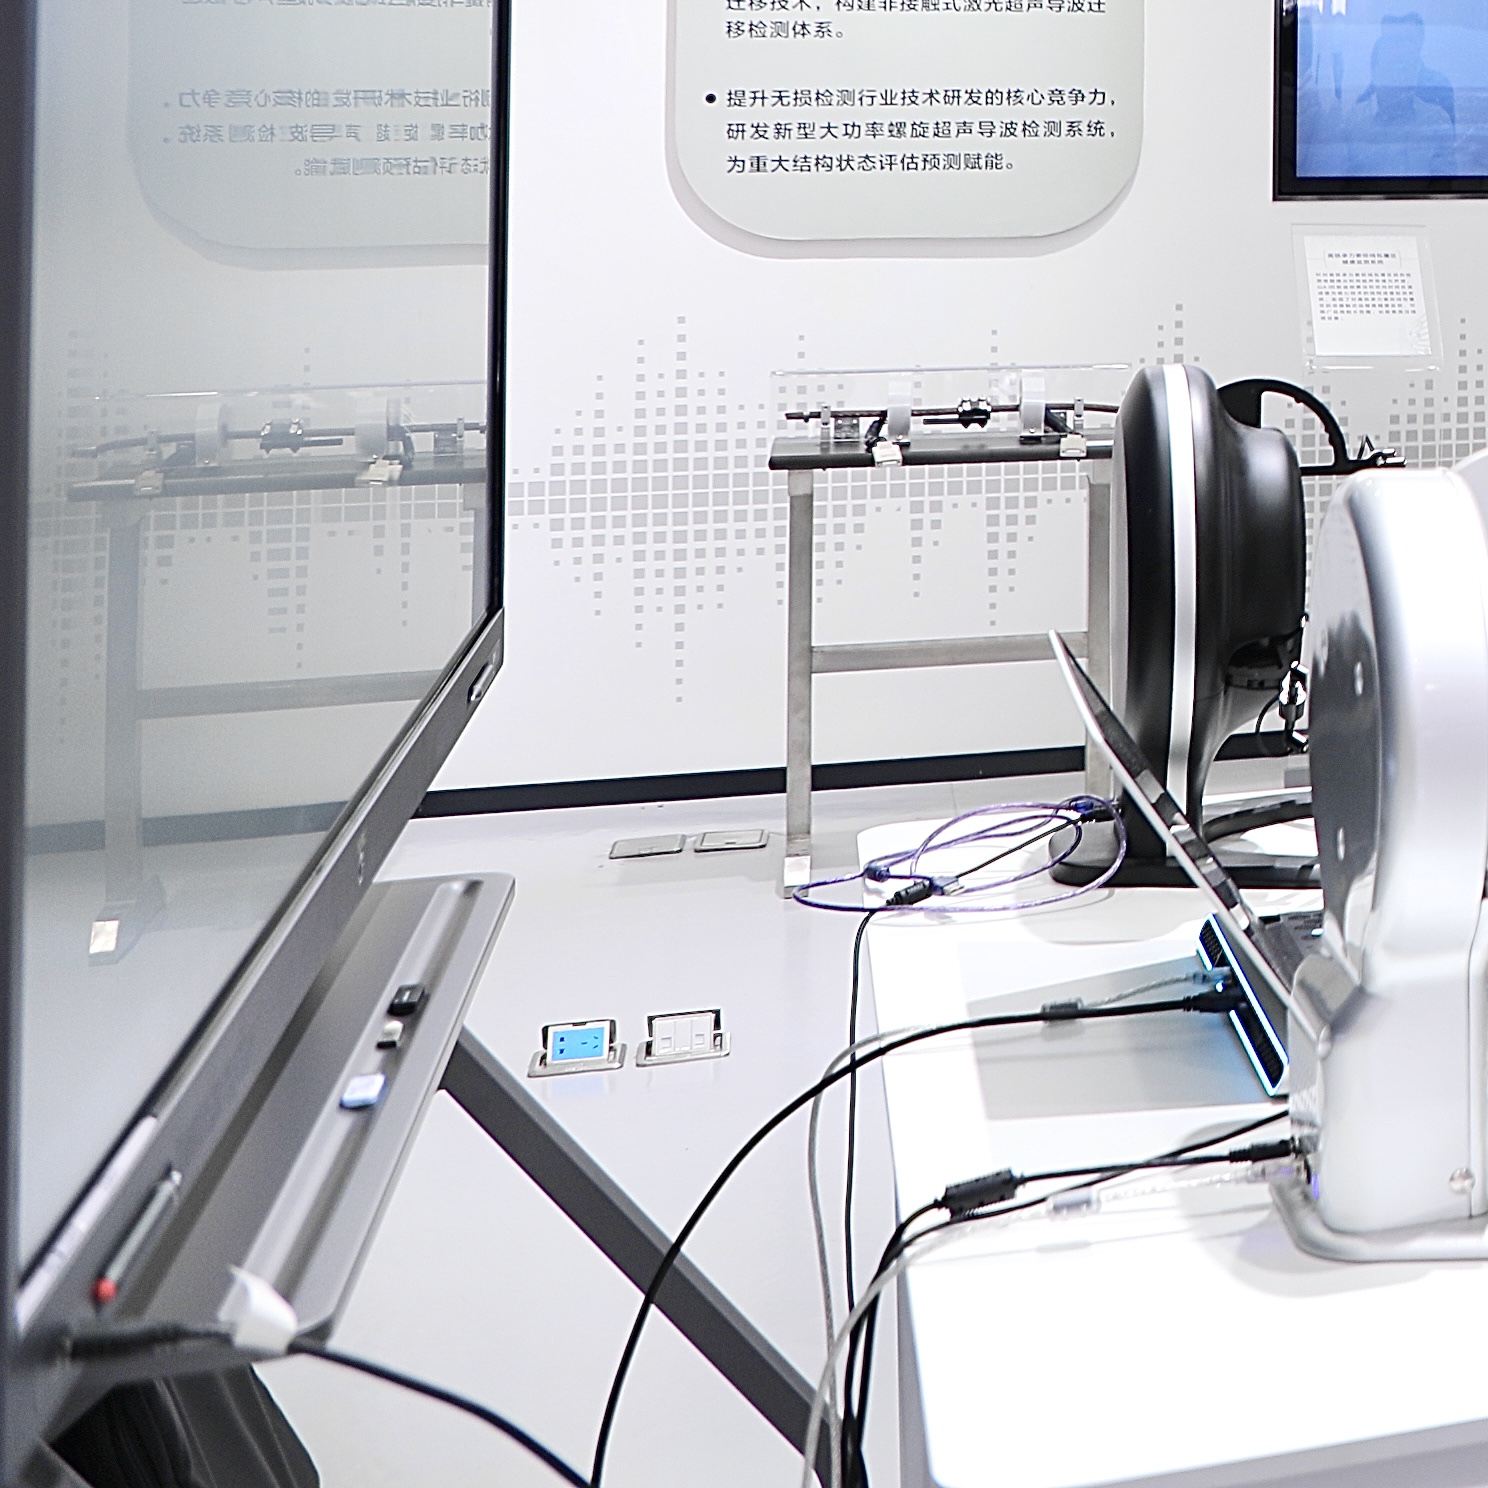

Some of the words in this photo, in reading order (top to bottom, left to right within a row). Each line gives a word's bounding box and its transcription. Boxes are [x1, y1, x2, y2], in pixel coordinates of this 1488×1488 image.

[725, 19, 845, 39] 移检测体系。
[726, 152, 1016, 174] 为重大结构状态评估预测赋能。
